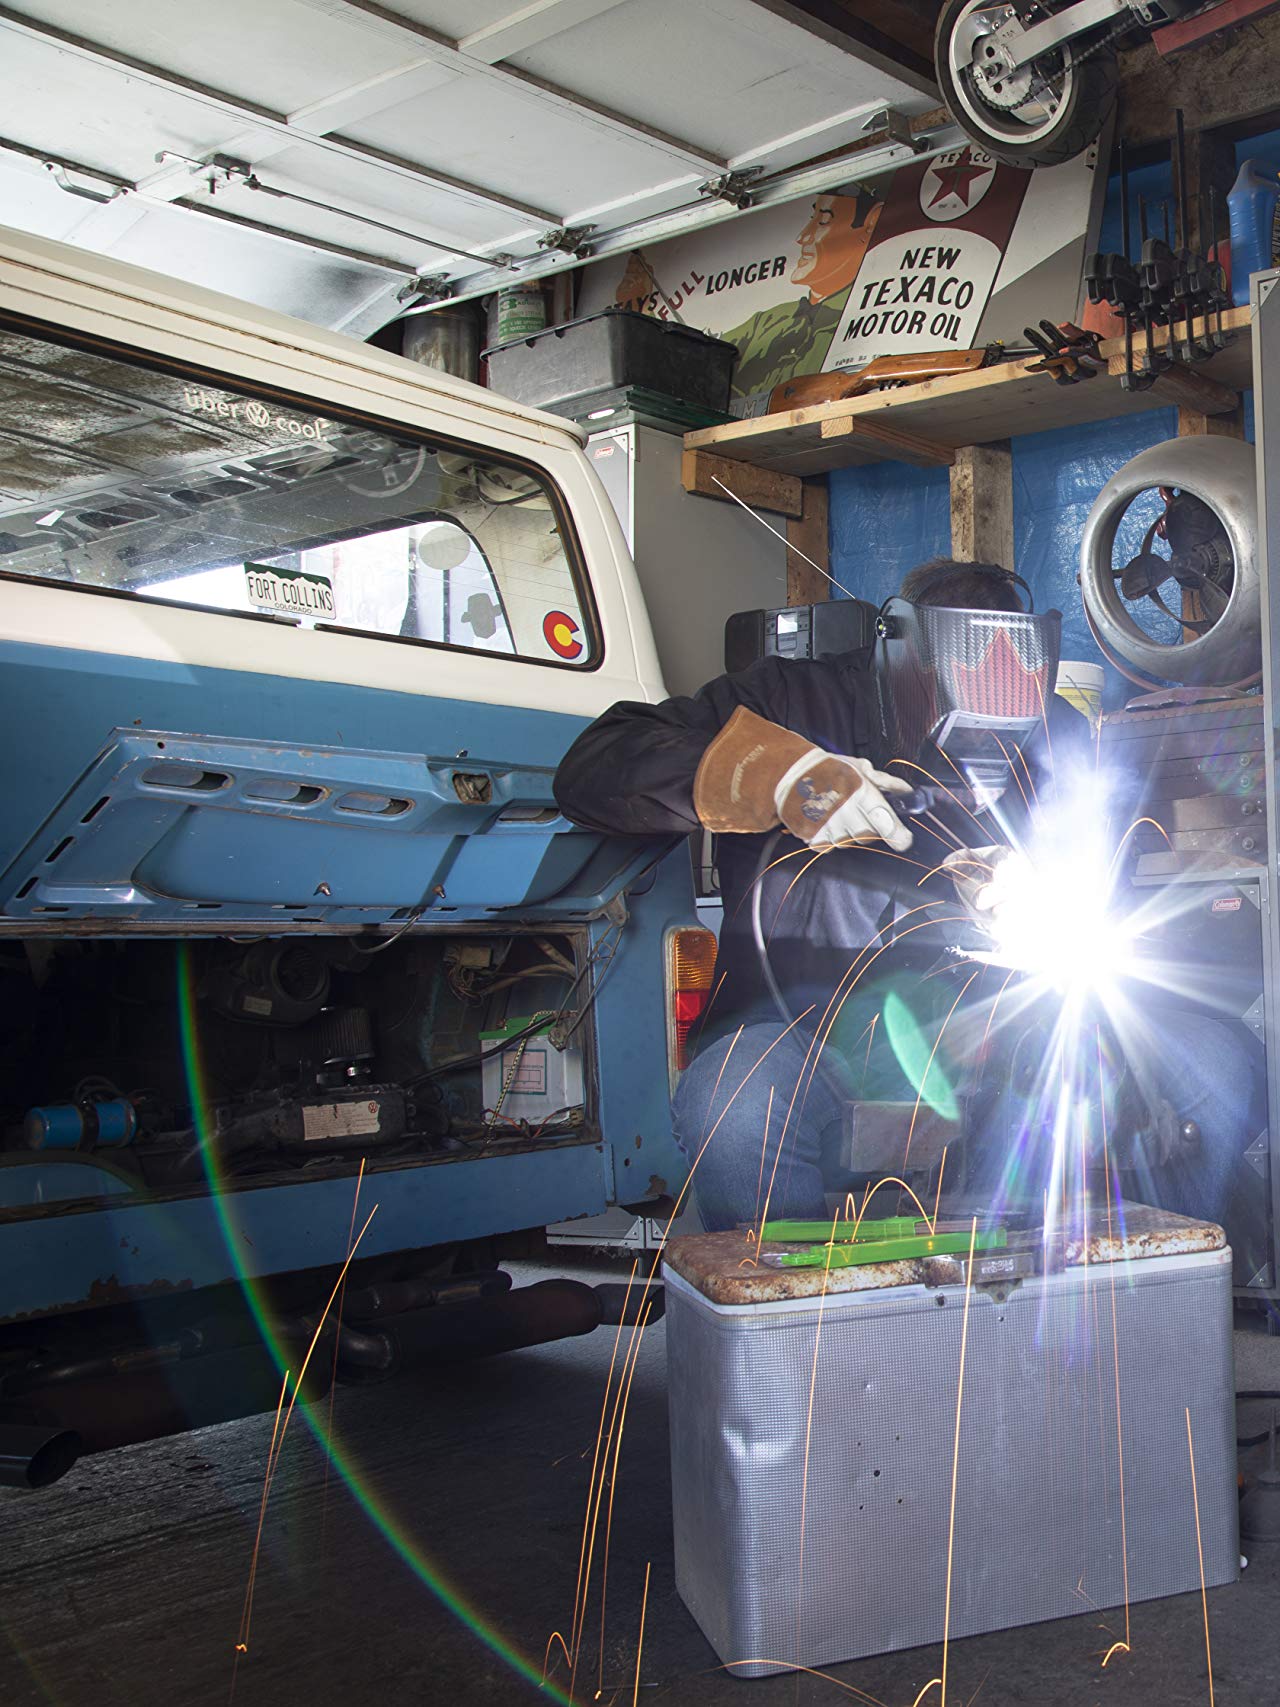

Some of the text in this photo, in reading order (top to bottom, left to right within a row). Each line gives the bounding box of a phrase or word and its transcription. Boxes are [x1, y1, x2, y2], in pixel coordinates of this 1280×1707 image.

[939, 151, 992, 164] TEXACO
[899, 247, 961, 270] NEW
[657, 271, 705, 321] FULL
[705, 255, 788, 296] LONGER
[859, 276, 974, 310] TEXACO
[843, 309, 961, 342] MOTOR OIL
[183, 388, 241, 419] über
[248, 576, 333, 612] FORT COLLINS
[274, 602, 313, 615] COLORADO
